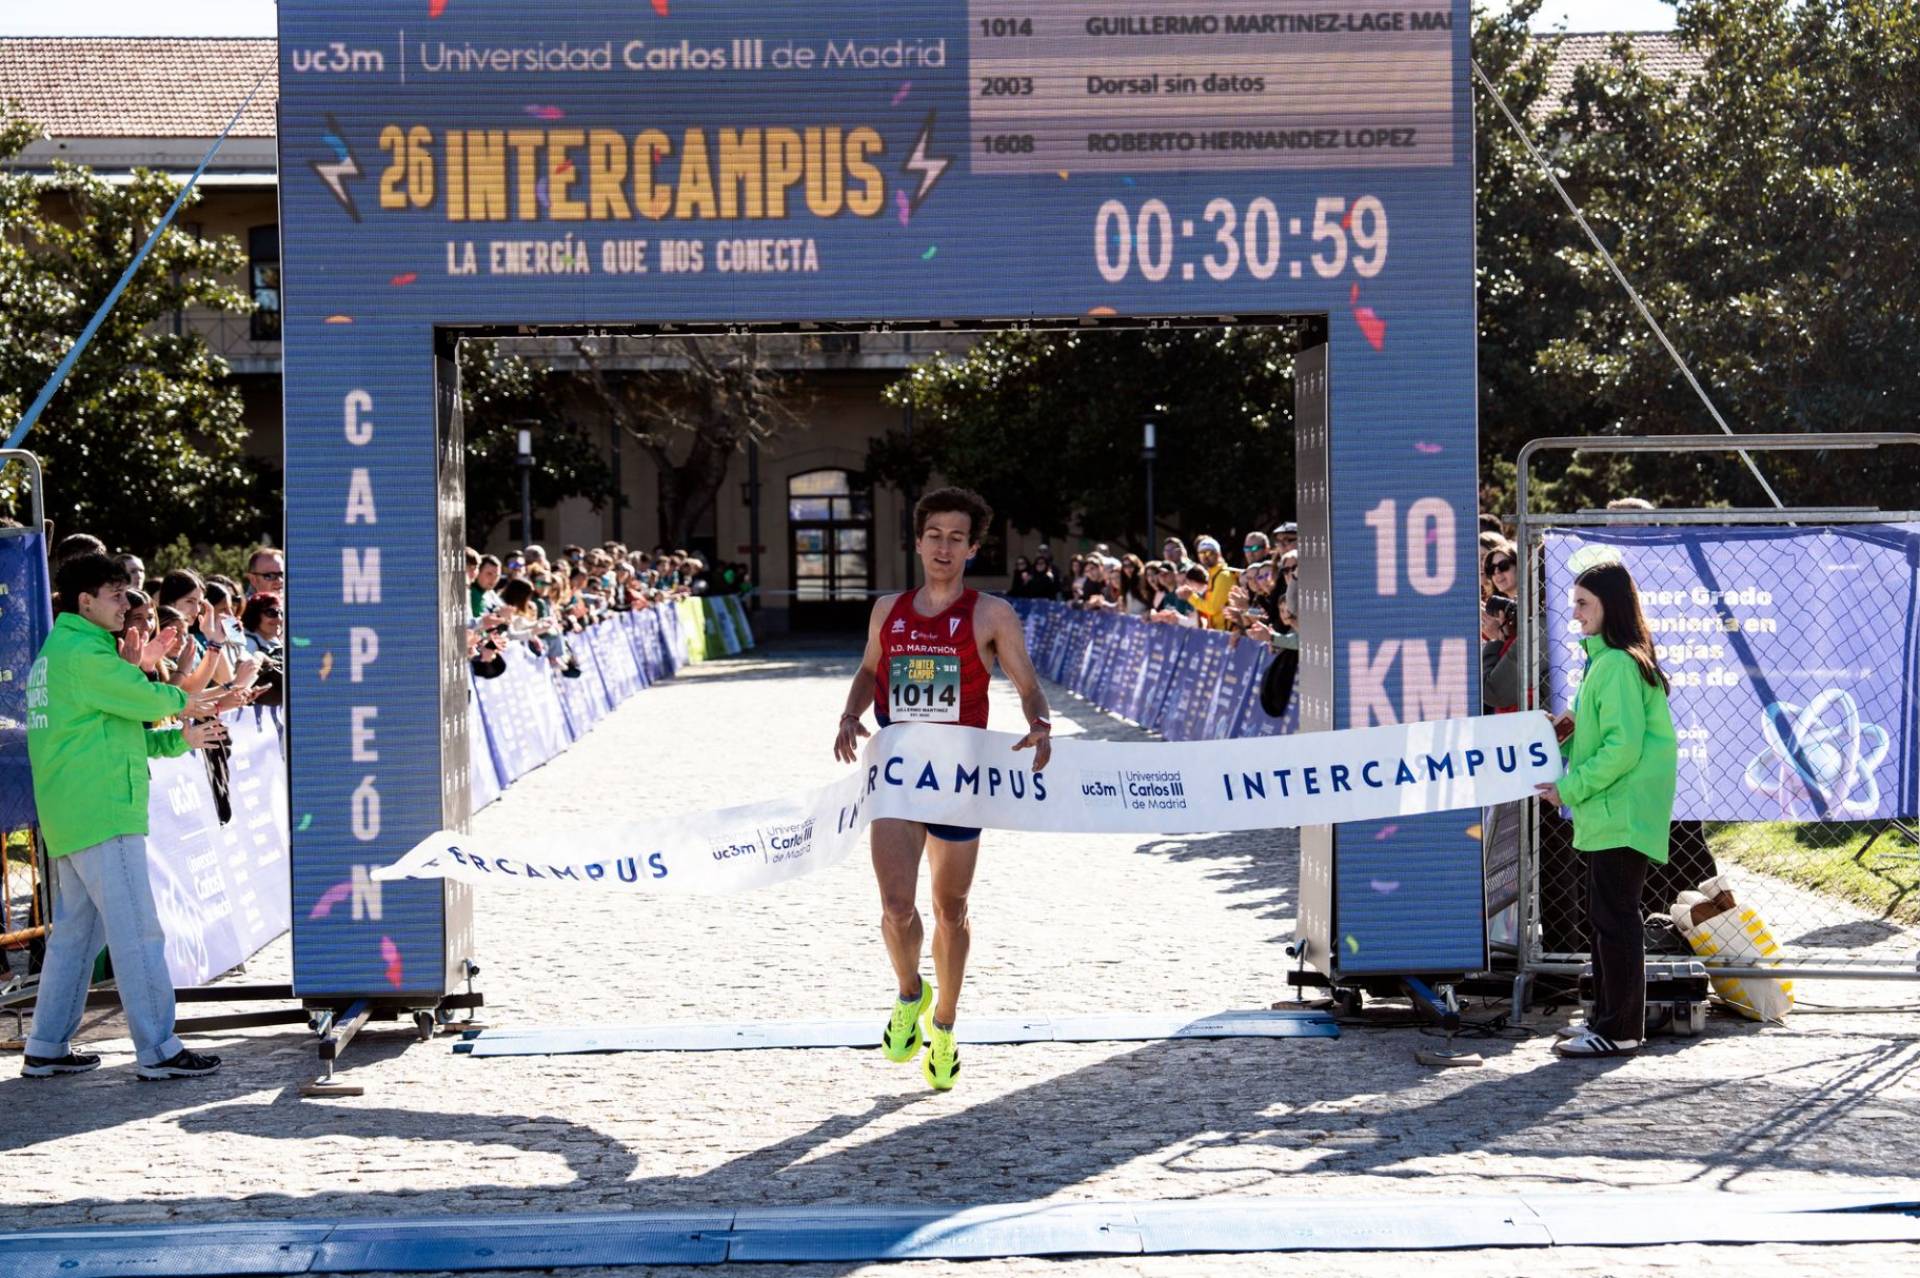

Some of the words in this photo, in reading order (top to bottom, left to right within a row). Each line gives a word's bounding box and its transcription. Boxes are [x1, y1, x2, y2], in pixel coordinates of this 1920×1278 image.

[980, 17, 1033, 38] 1014
[1086, 15, 1219, 36] GUILLERMO
[1224, 12, 1404, 34] MARTINEZ-LAGE
[292, 41, 384, 72] uc3m
[420, 40, 611, 72] Universidad
[623, 39, 726, 71] Carlos
[732, 39, 762, 70] III
[772, 39, 815, 71] de
[823, 38, 945, 70] Madrid
[981, 77, 1033, 96] 2003
[1087, 74, 1159, 96] Dorsal
[1164, 74, 1196, 93] sin
[1202, 73, 1265, 93] datos
[983, 134, 1034, 155] 1608
[1087, 132, 1196, 153] ROBERTO
[1201, 130, 1341, 151] HERNANDEZ
[1344, 128, 1416, 149] LOPEZ
[379, 124, 433, 208] 26
[445, 126, 885, 220] INTERCAMPUS
[1095, 194, 1389, 283] 00:30:59
[447, 242, 476, 274] LA
[491, 233, 590, 274] ENERGÍA
[602, 240, 646, 273] QUE
[660, 239, 704, 273] NOS
[717, 238, 819, 273] CONECTA
[1365, 497, 1456, 596] 10
[1691, 586, 1772, 605] Grado
[1648, 612, 1739, 633] eniería
[1744, 618, 1777, 632] en
[341, 388, 384, 921] CAMPEÓN
[907, 644, 957, 655] MARATHON
[1348, 638, 1468, 729] KM
[1706, 667, 1740, 687] de
[892, 683, 956, 707] 1014
[838, 756, 1047, 834] INRCAMPUS
[1081, 781, 1117, 797] uc3m
[1223, 742, 1548, 801] INTERCAMPUS
[1125, 770, 1181, 782] Universidad
[1129, 782, 1169, 797] Carlos
[1170, 782, 1184, 796] III
[1132, 799, 1146, 809] de
[1148, 799, 1187, 810] Madrid
[767, 816, 817, 836] Univer
[771, 834, 803, 850] Carlo
[422, 846, 668, 883] ERCAMPUS
[712, 843, 757, 861] uc3m
